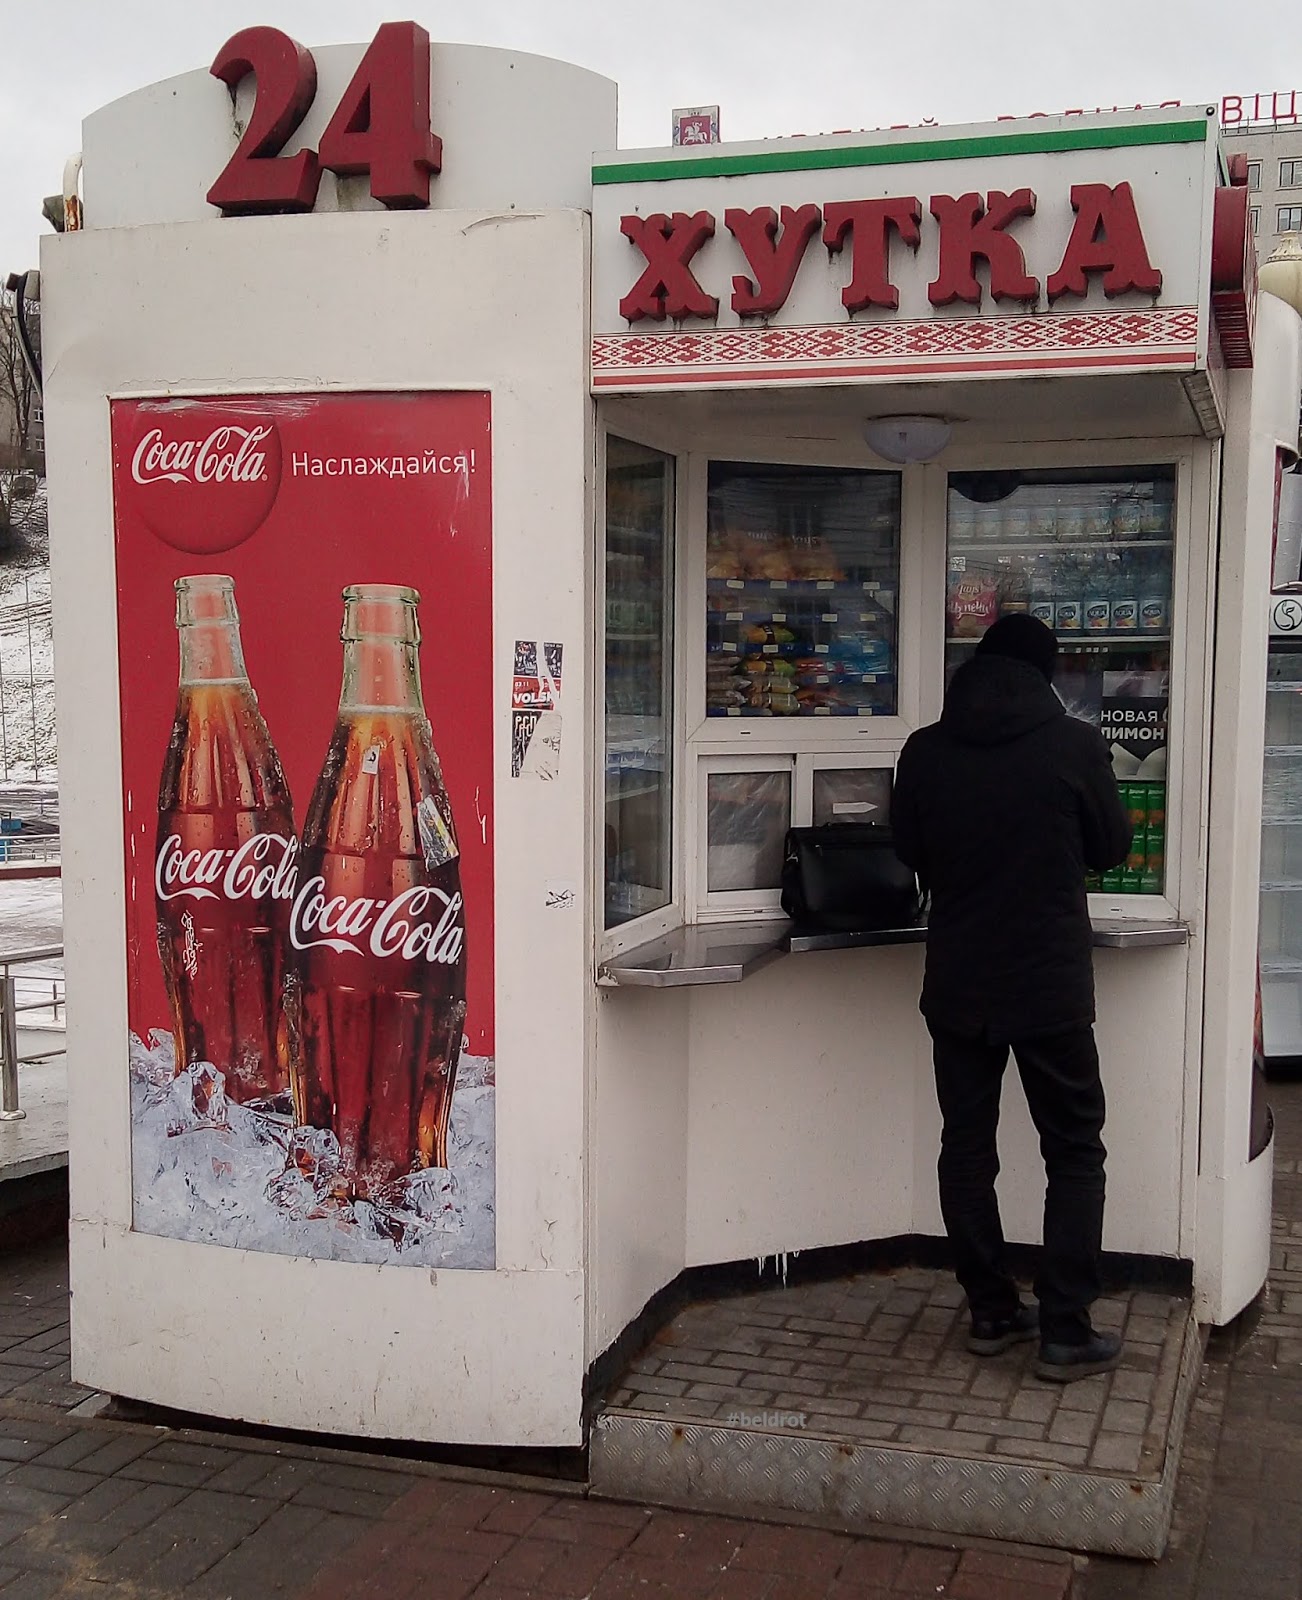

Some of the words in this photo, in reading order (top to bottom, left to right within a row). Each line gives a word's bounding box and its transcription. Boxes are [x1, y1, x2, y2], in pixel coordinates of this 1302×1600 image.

[207, 21, 442, 216] 24
[619, 181, 1162, 322] ХУТКА
[131, 425, 273, 484] Coca-Cola
[292, 449, 476, 479] Наслаждайся!
[1100, 710, 1158, 722] НОВАЯ
[155, 833, 299, 901] Coca-Cola
[289, 876, 464, 965] Coca-Cola
